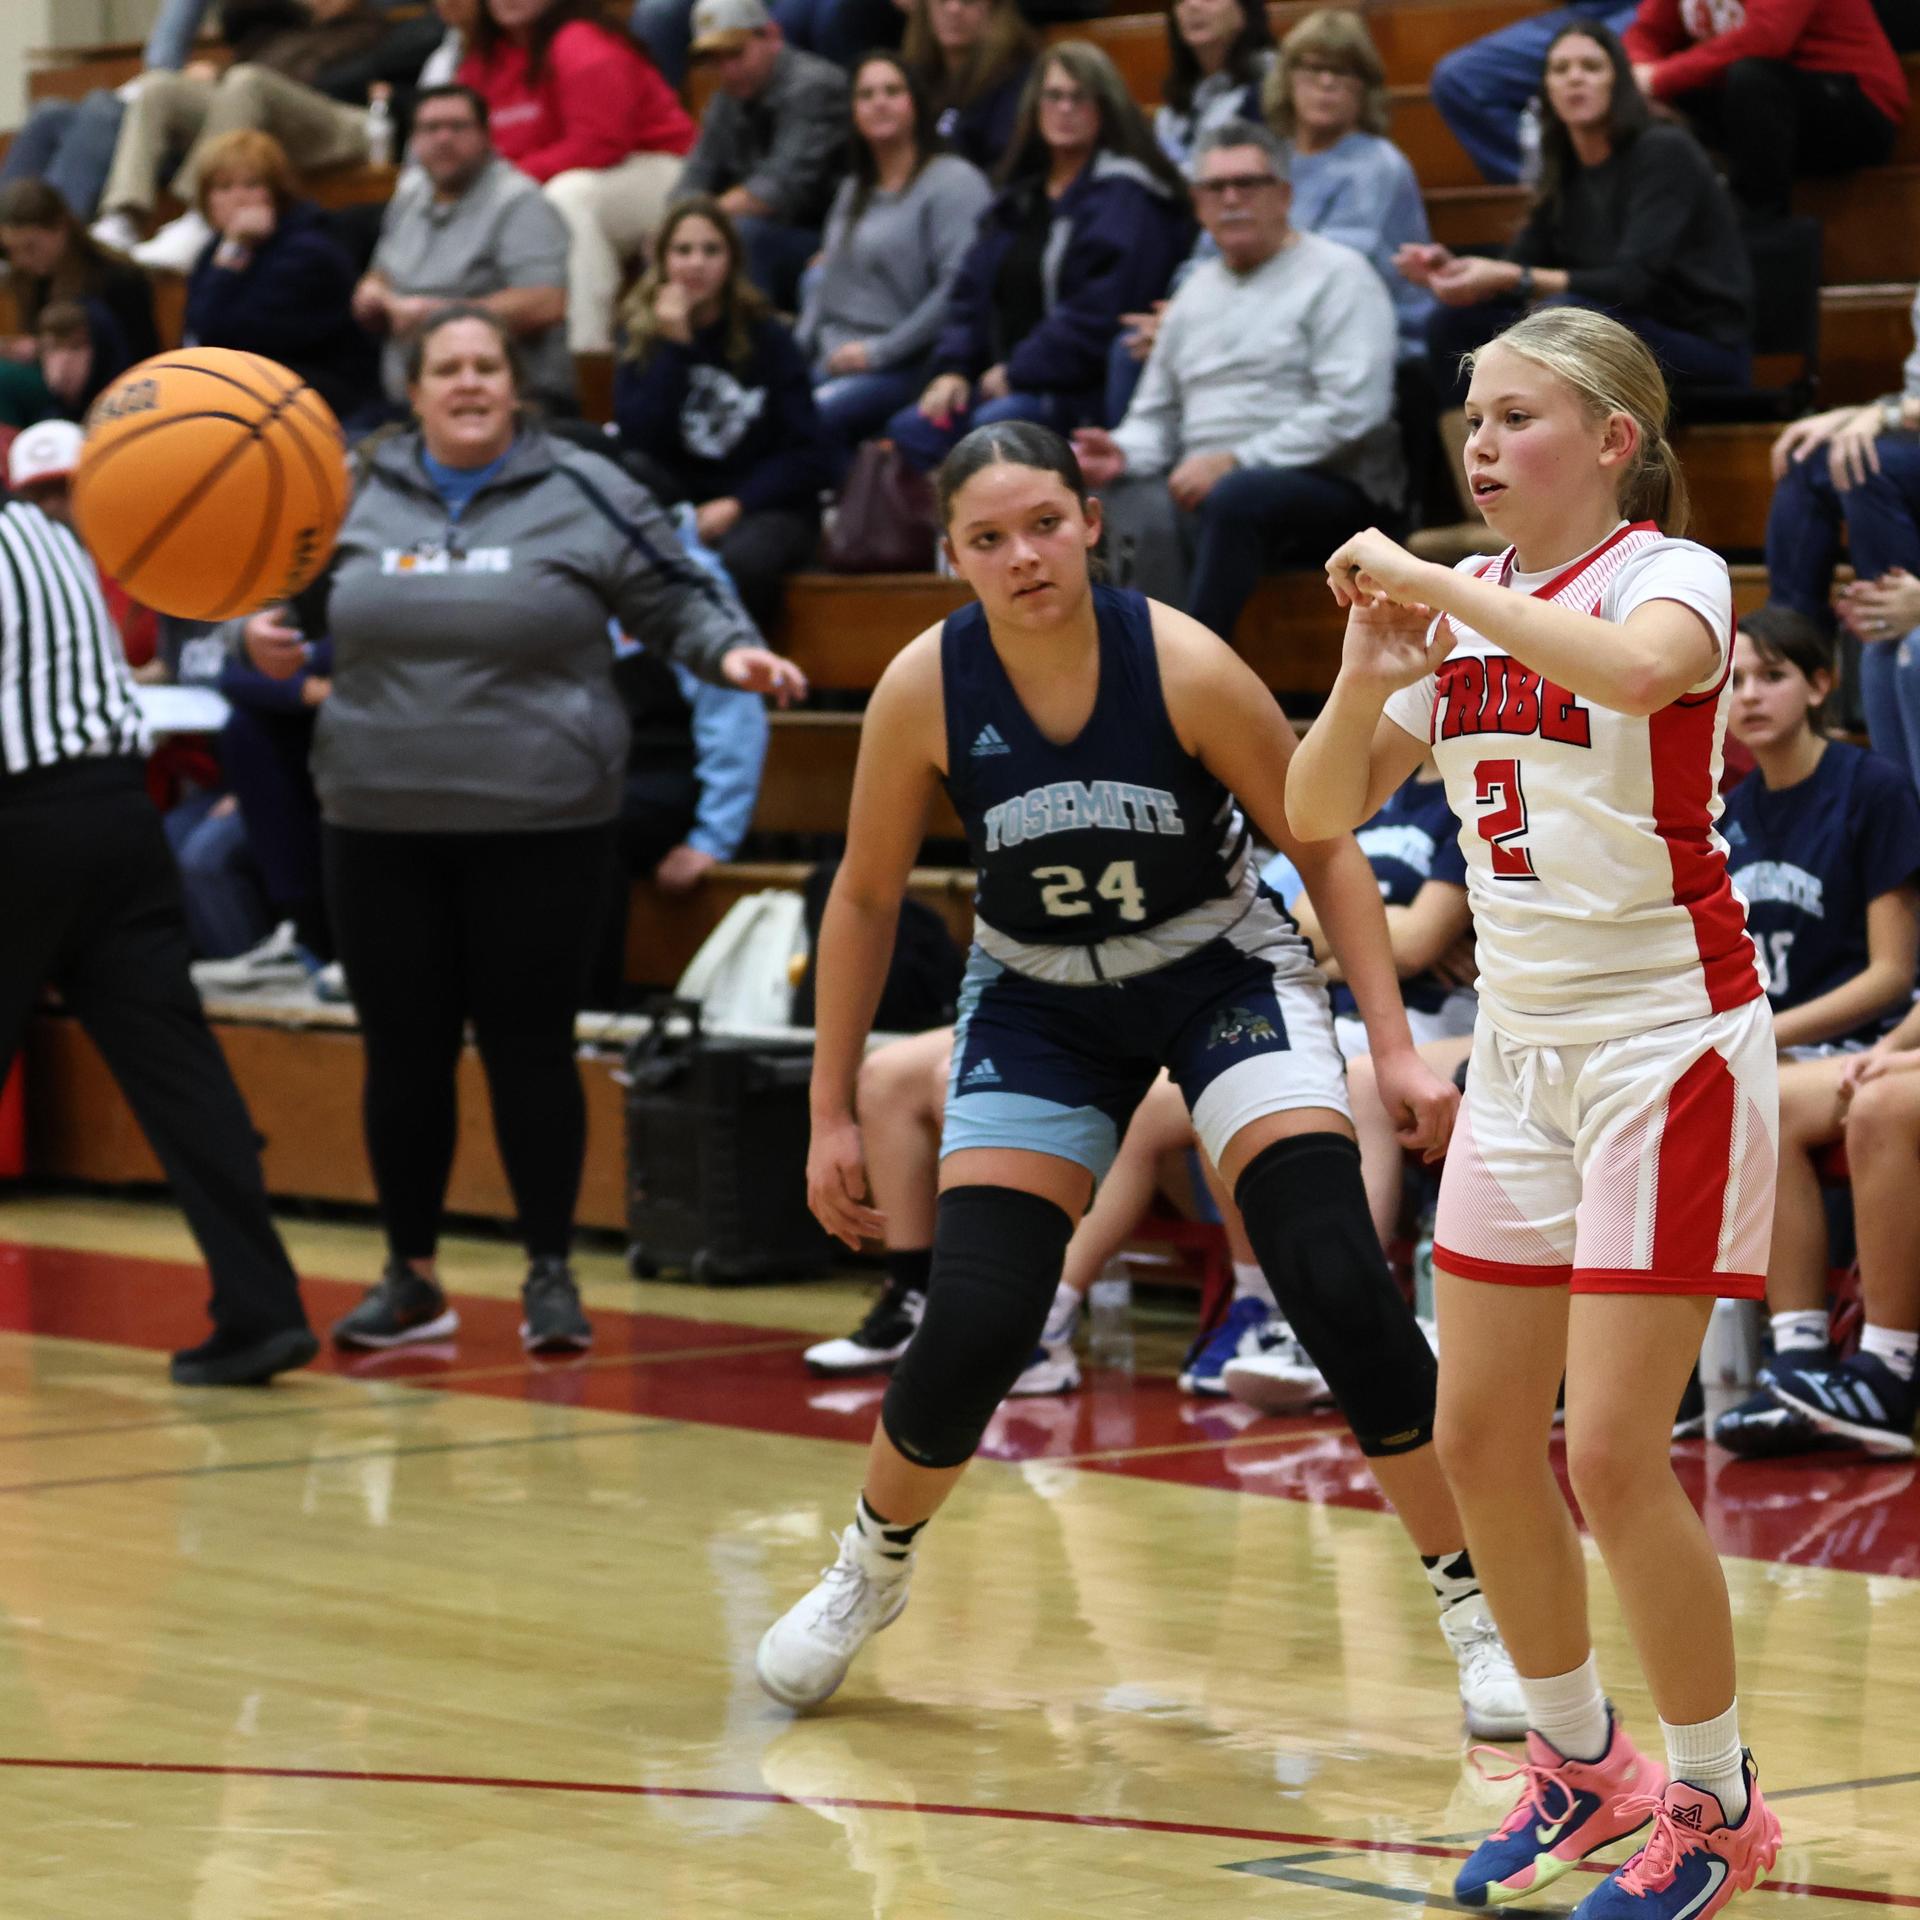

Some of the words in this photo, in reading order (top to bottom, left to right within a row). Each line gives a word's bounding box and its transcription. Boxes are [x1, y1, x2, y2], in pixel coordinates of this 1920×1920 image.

[984, 781, 1185, 852] YOSEMITE
[1473, 758, 1541, 882] 2
[1031, 860, 1146, 921] 24
